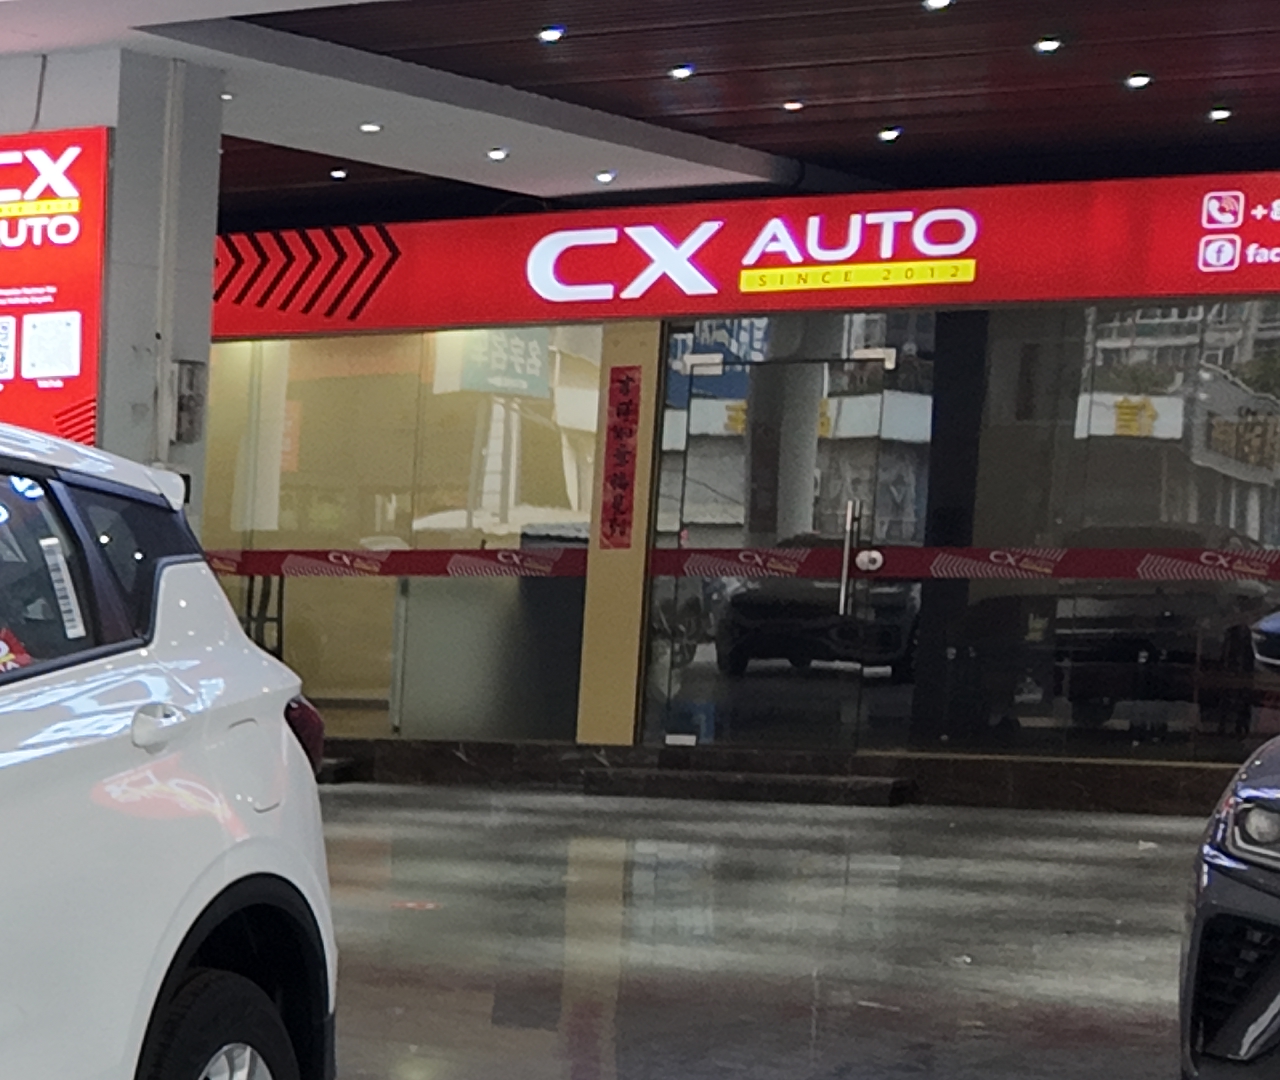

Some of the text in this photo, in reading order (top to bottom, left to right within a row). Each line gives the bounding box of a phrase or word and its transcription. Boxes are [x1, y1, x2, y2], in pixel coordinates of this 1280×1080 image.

[741, 208, 978, 266] AUTO
[526, 221, 724, 302] CX
[759, 264, 961, 287] SINCE 2012
[1199, 551, 1232, 568] CX
